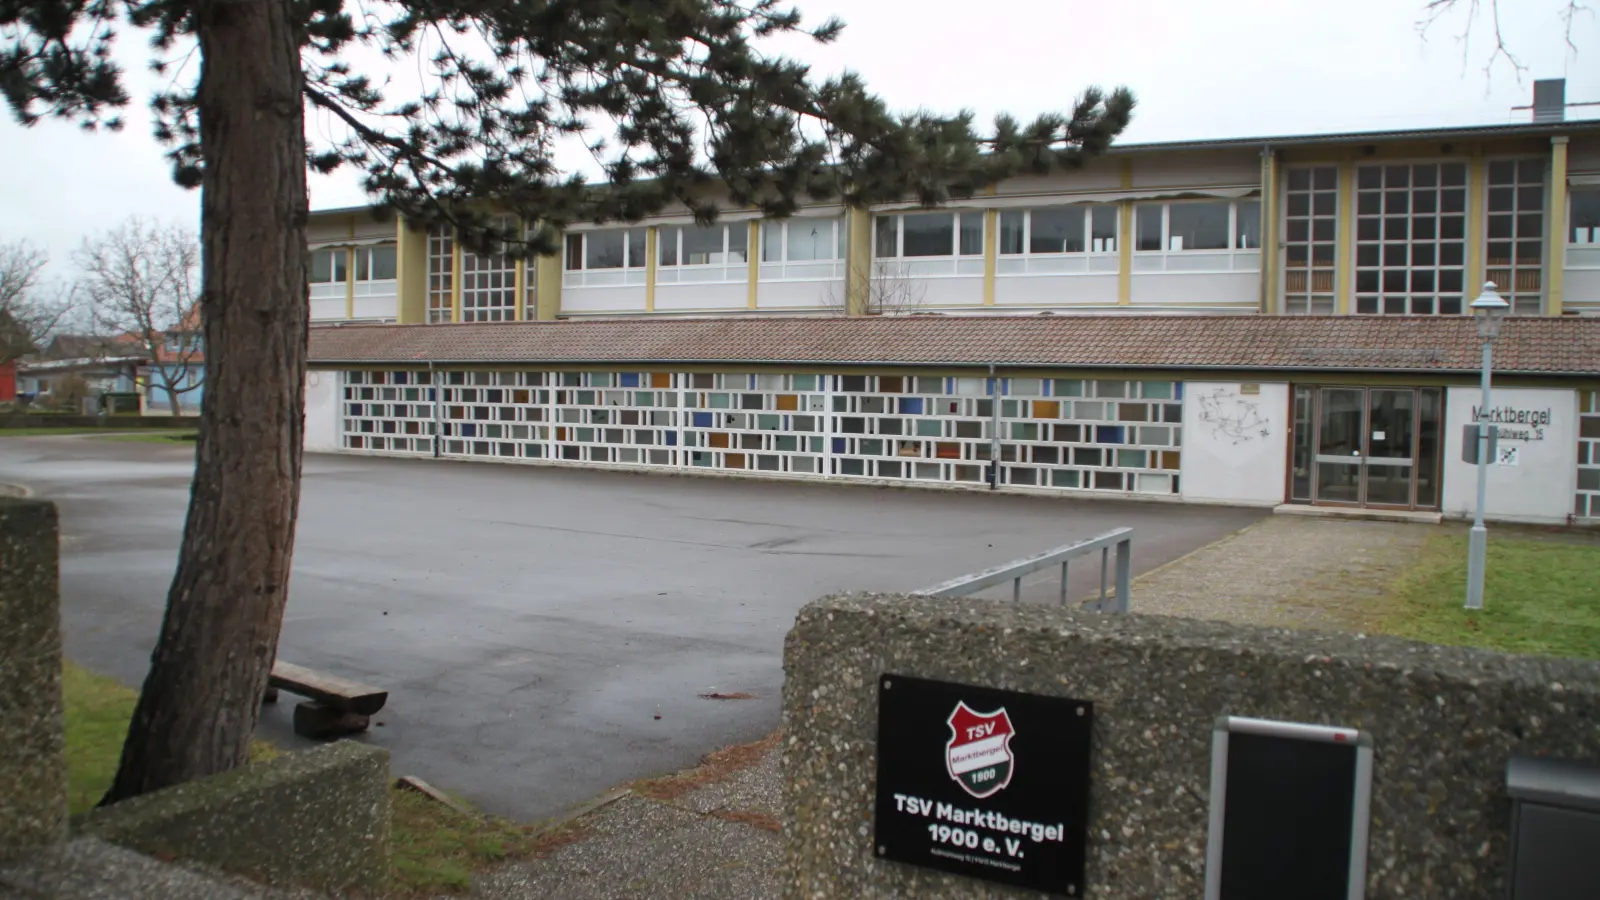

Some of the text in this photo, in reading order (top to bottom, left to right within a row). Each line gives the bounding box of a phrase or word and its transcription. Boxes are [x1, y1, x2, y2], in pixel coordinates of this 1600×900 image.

[1472, 405, 1550, 427] Mrktbergel
[966, 721, 996, 740] TSV
[952, 744, 1004, 764] Marktbergel
[971, 768, 996, 784] 1900
[894, 792, 1065, 842] TSV Marktbergel
[928, 824, 979, 849] 1900
[982, 837, 1002, 854] e.
[1004, 836, 1025, 858] V.
